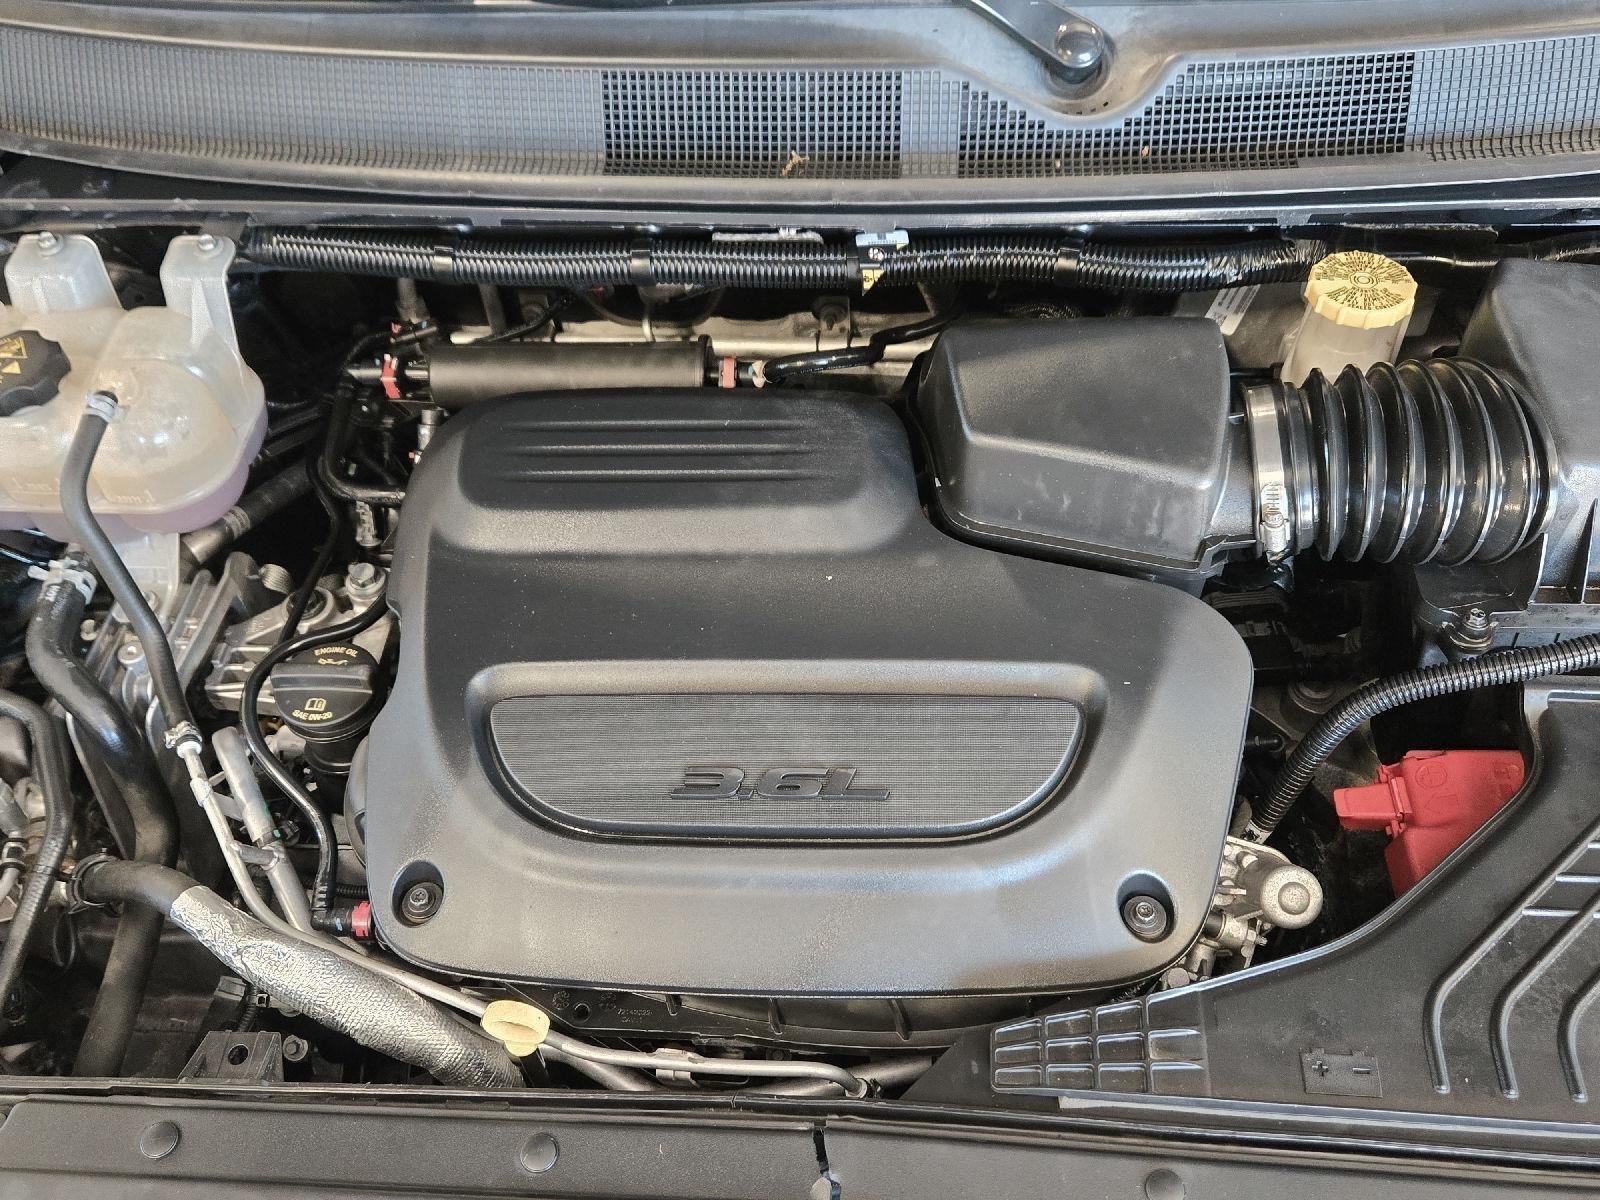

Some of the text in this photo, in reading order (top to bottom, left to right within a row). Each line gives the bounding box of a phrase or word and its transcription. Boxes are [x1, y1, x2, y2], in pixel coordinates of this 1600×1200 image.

[314, 646, 358, 657] ENGINE OIL
[292, 709, 333, 721] SAE 0W-20
[671, 766, 891, 801] 3.6L
